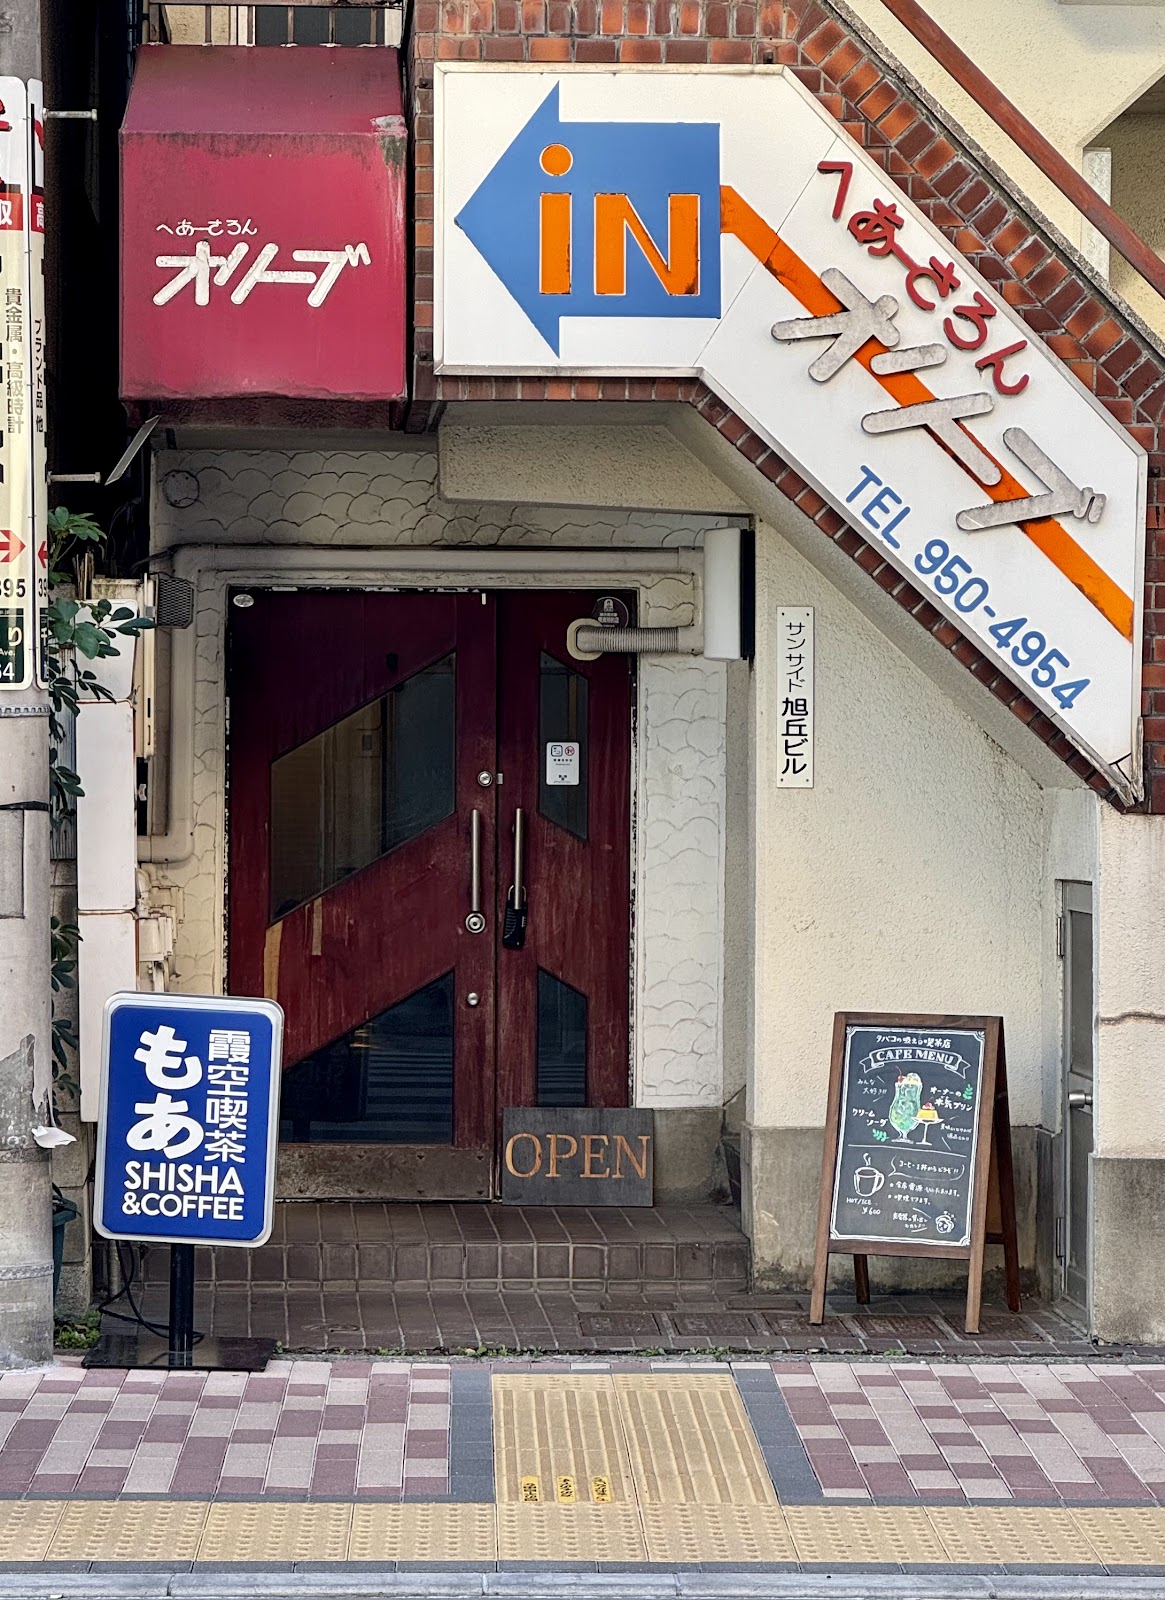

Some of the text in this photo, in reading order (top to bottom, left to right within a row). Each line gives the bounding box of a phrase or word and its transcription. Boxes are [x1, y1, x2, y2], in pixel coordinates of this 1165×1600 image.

[156, 218, 258, 237] へあーさろん
[153, 240, 372, 307] オリーブ
[817, 161, 1030, 396] へあーさろん
[771, 267, 1107, 531] オリーブ
[846, 464, 1091, 709] TEL 950-4954
[876, 1048, 955, 1064] CAFE MENU
[126, 1025, 205, 1160] もあ
[204, 1029, 250, 1163] 霞空喫茶
[124, 1160, 245, 1195] SHISHA
[505, 1132, 651, 1179] OPEN
[122, 1192, 244, 1220] &COFFEE
